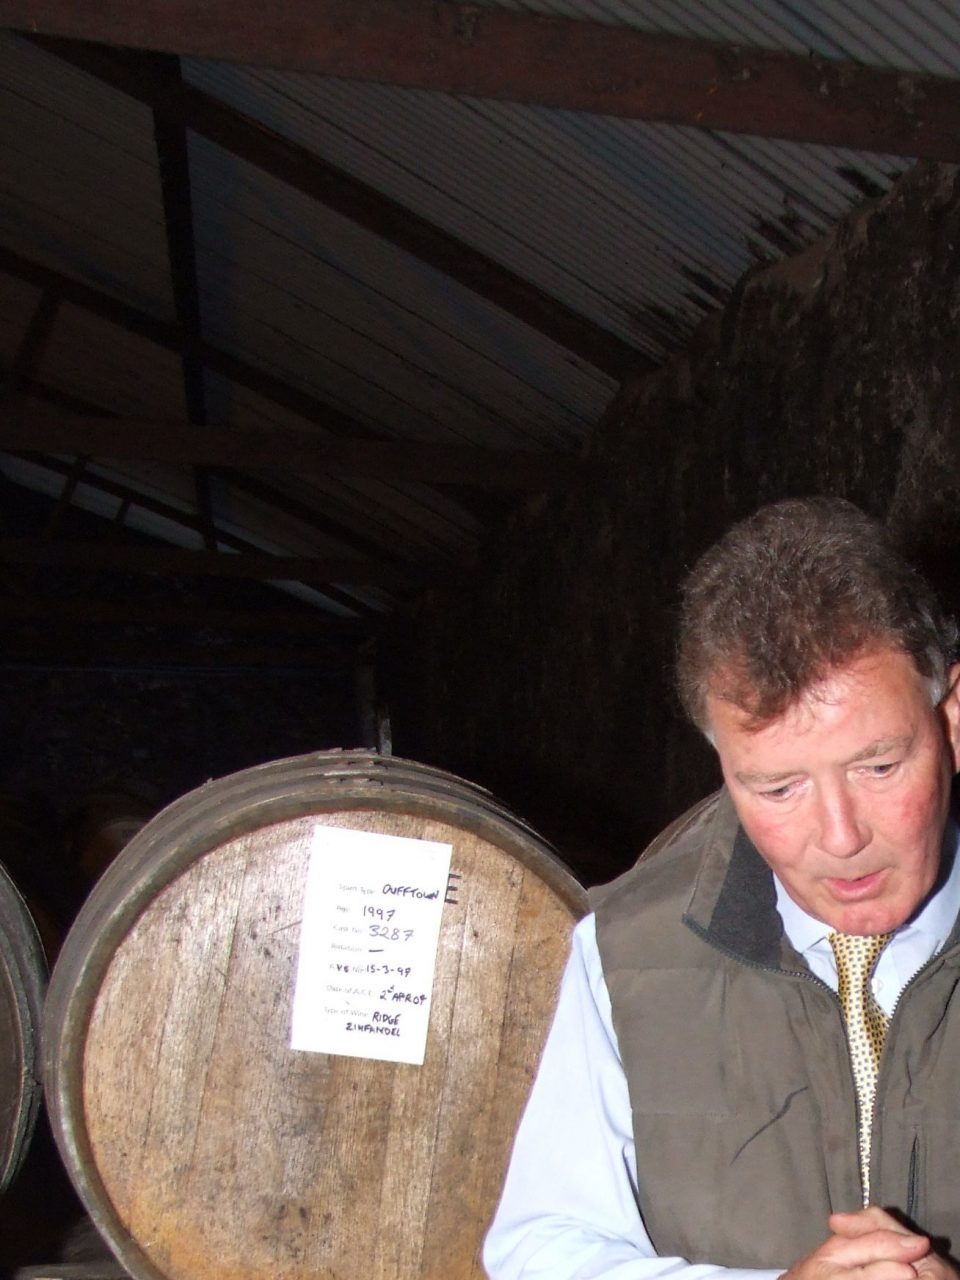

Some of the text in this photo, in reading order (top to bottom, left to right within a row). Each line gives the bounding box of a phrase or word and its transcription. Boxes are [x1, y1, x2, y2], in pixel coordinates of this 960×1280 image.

[363, 905, 396, 922] 1997
[369, 924, 414, 941] 3287
[371, 1011, 402, 1026] RIDGE
